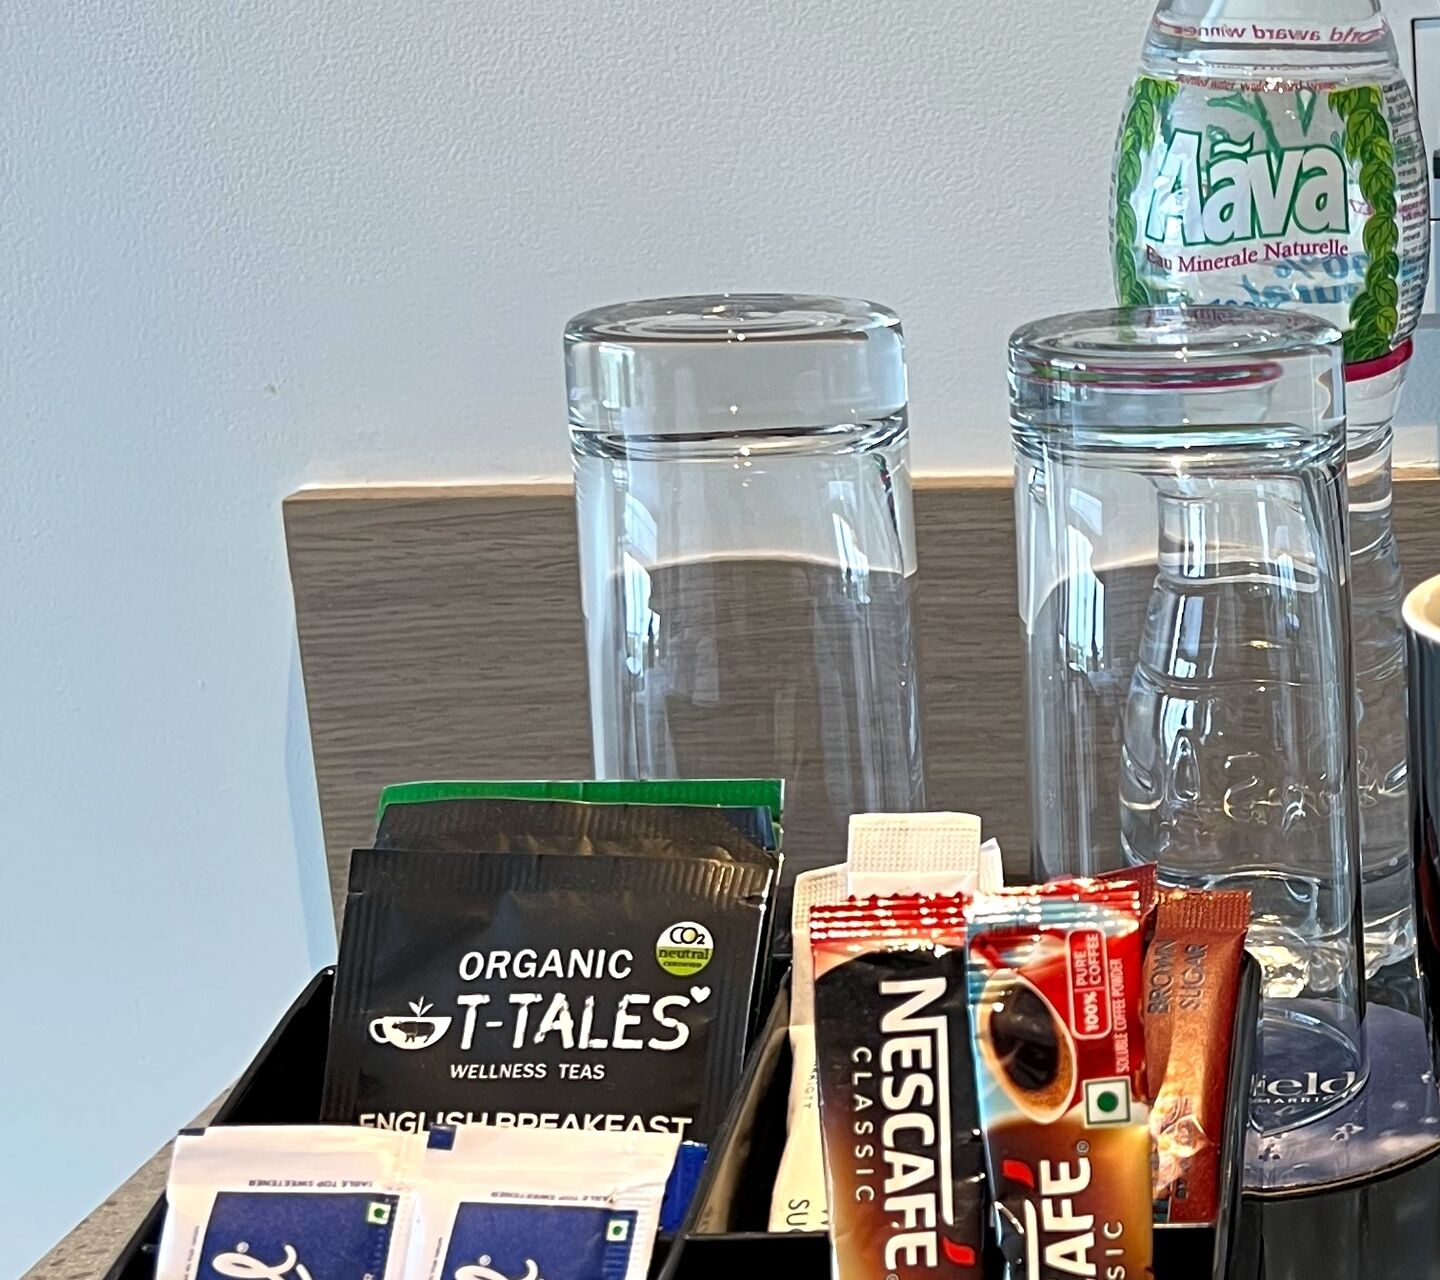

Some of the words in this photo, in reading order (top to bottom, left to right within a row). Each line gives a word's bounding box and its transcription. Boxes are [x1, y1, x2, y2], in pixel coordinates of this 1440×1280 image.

[1145, 243, 1173, 271] Eau
[1178, 246, 1259, 272] Minerale
[1263, 238, 1349, 261] Naturelle
[457, 948, 634, 981] ORGANIC
[658, 948, 710, 961] neutral
[1073, 950, 1089, 987] PURE
[1086, 932, 1102, 985] COFFEE
[1147, 938, 1178, 1014] BROWN
[1178, 942, 1208, 1011] SUGAR
[455, 991, 693, 1052] T-TALES
[1083, 990, 1100, 1033] 100%
[449, 1063, 548, 1081] WELLNESS
[558, 1063, 606, 1081] TEAS
[850, 1045, 876, 1204] CLASSIC
